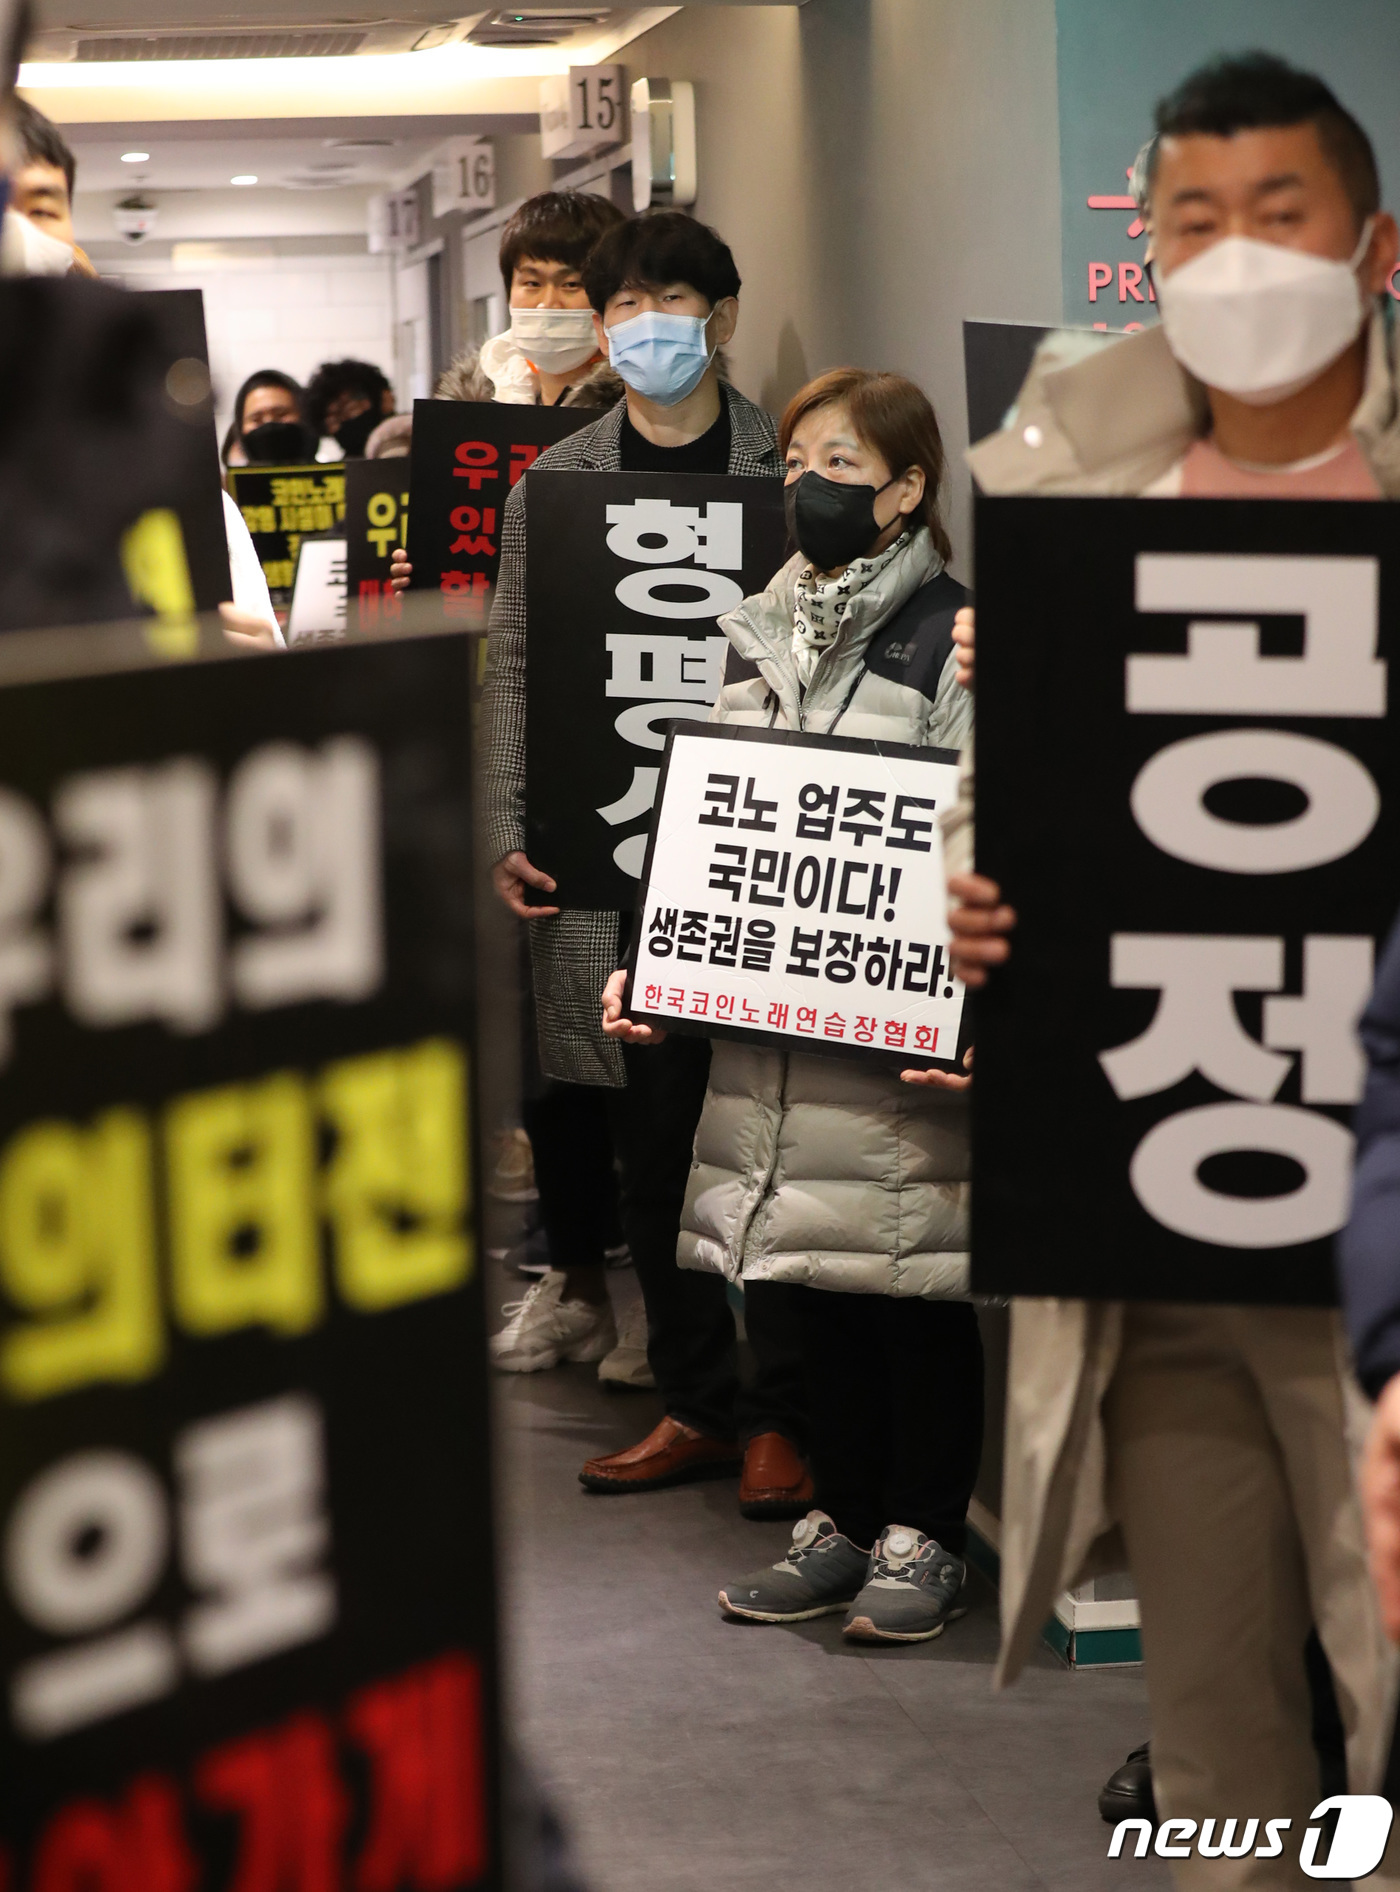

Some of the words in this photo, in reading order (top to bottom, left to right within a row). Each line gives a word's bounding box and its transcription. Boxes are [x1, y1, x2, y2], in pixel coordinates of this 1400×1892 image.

[577, 78, 615, 130] 15
[458, 155, 491, 198] 16
[698, 773, 778, 833] 코노
[795, 782, 936, 852] 업주도
[708, 843, 903, 923] 국민이다!
[648, 907, 776, 972] 생존권을
[643, 984, 940, 1053] 한국코인노래연습장협회
